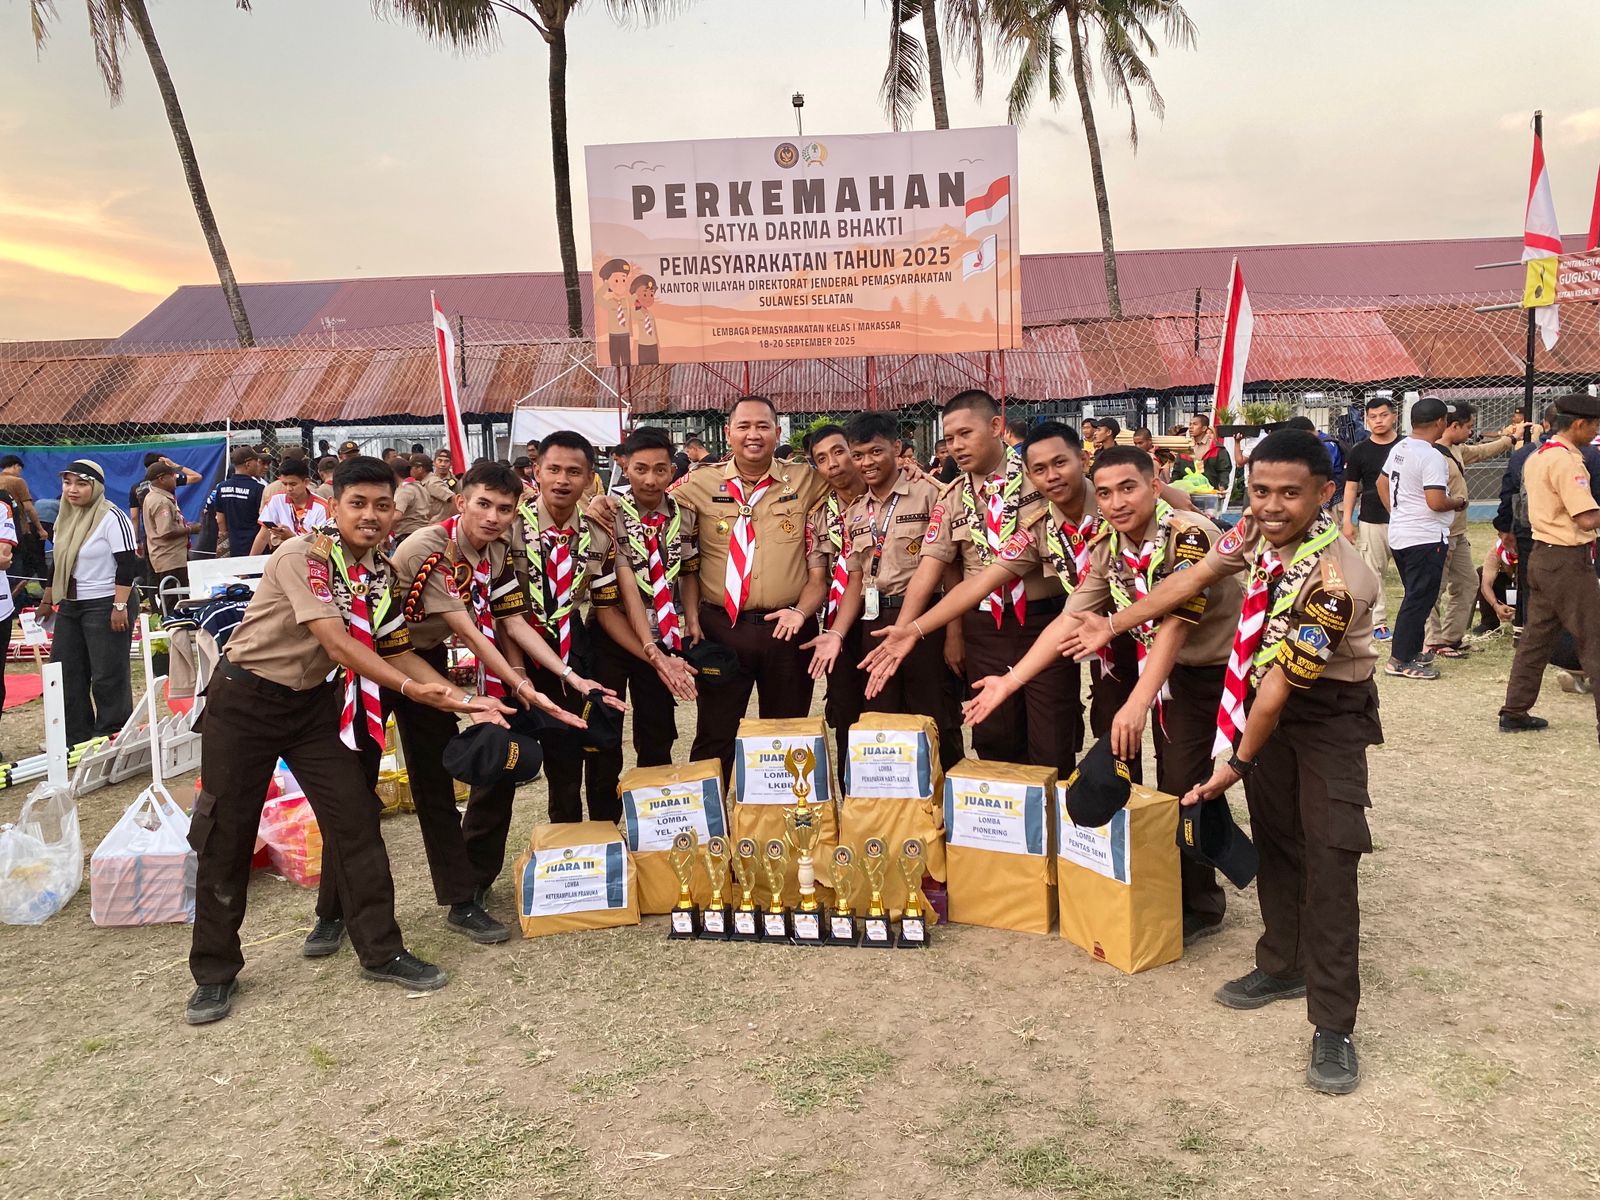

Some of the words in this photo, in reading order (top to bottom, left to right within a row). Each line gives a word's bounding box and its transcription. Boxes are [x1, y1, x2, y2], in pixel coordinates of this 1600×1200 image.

[632, 172, 965, 220] PERKEMAHAN
[704, 222, 759, 243] SATYA
[765, 219, 831, 241] DARMA
[837, 217, 903, 238] BHAKTI
[660, 252, 827, 276] PEMASYARAKATAN
[834, 248, 895, 270] TAHUN
[902, 246, 951, 267] 2025
[660, 281, 699, 294] KANTOR
[702, 280, 745, 293] WILAYAH
[748, 278, 808, 291] DIREKTORAT
[811, 276, 859, 289] JENDERAL
[862, 271, 952, 287] PEMASYARAKATAN
[1559, 271, 1590, 285] GUGUS
[760, 295, 809, 307] SULAWESI
[812, 293, 854, 306] SELATAN
[712, 327, 750, 337] LEMBAGA
[752, 324, 824, 336] PEMASYARAKATAN
[826, 323, 851, 333] KELAS
[858, 321, 901, 332] MAKASSAR
[760, 340, 783, 349] 18-20
[785, 338, 832, 348] SEPTEMBER
[834, 336, 856, 346] 2025
[759, 754, 785, 763] JUAR
[863, 747, 896, 756] JUARA
[649, 799, 681, 811] JUARA
[682, 796, 690, 805] II
[964, 795, 1002, 809] JUARA
[1004, 801, 1013, 809] II
[657, 815, 688, 826] LOMBA
[978, 816, 1001, 825] LOMBA
[655, 828, 672, 836] YEL
[972, 826, 1008, 837] PIONERING
[1075, 830, 1096, 844] LOMBA
[1068, 838, 1091, 854] PENTAS
[1091, 847, 1107, 859] SENI
[545, 862, 580, 874] JUARA
[582, 861, 595, 870] III
